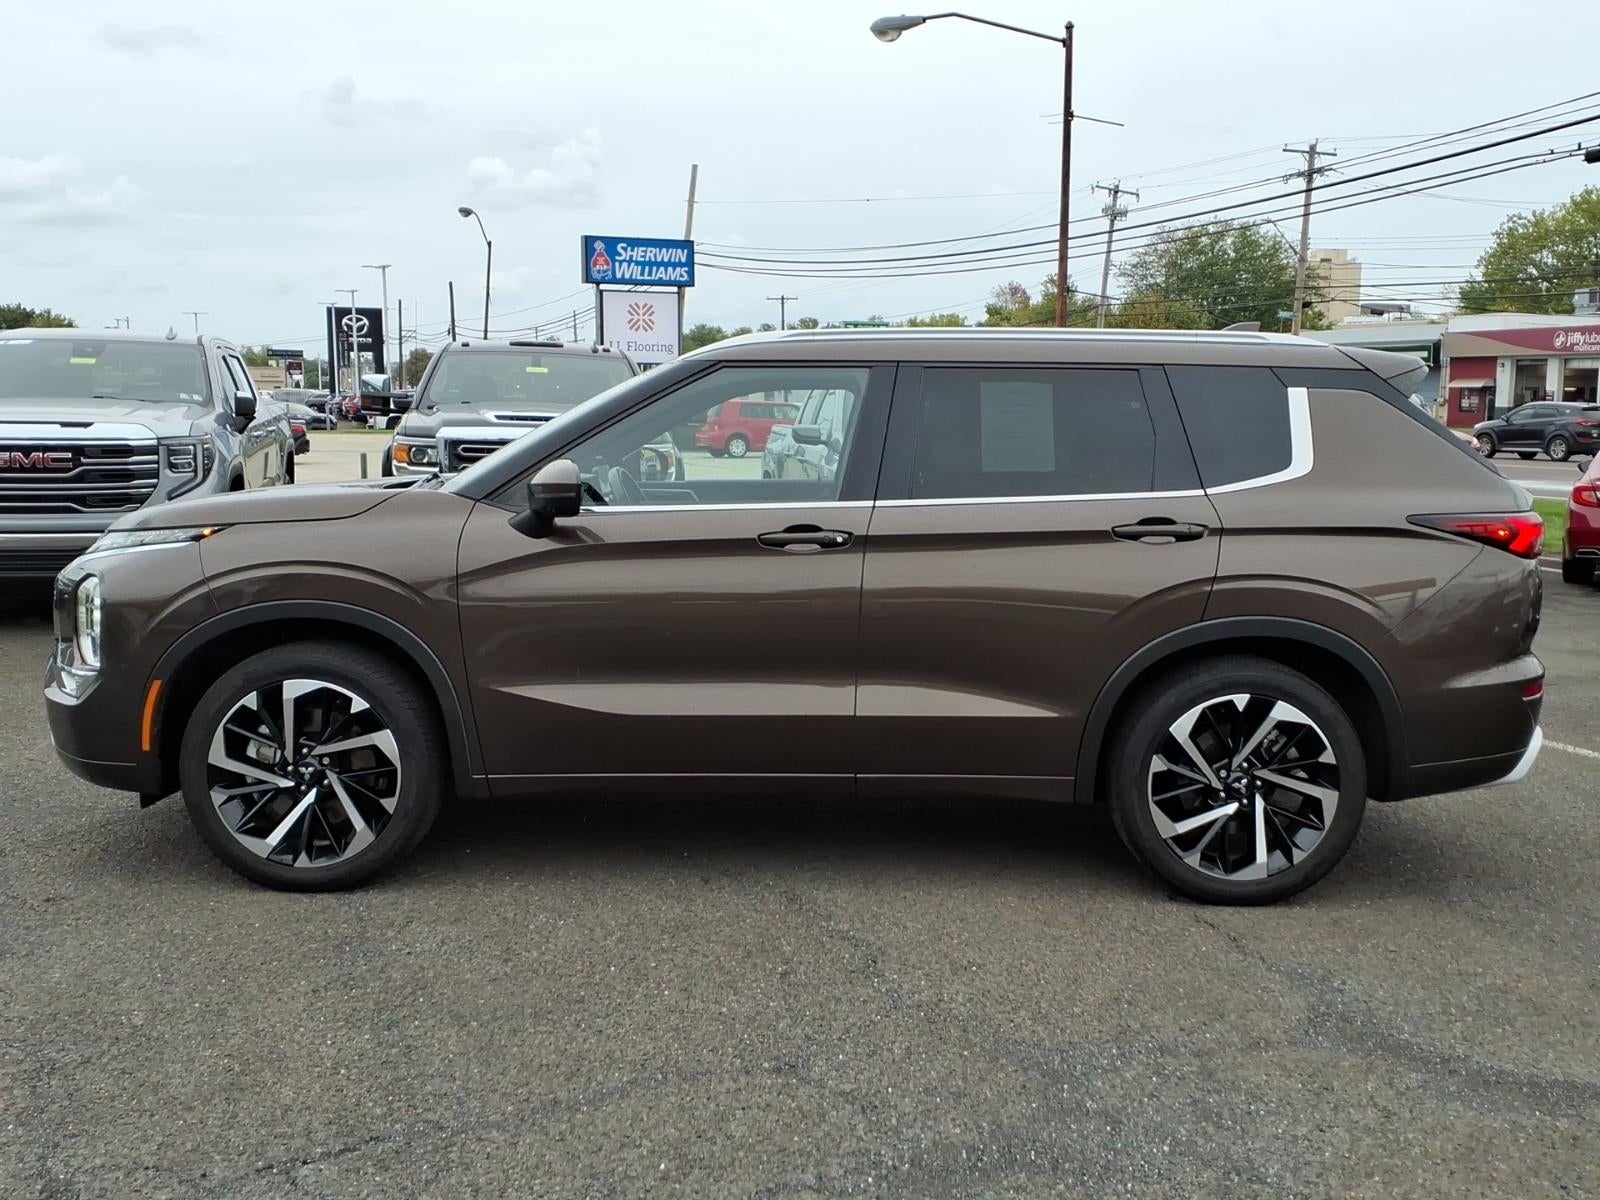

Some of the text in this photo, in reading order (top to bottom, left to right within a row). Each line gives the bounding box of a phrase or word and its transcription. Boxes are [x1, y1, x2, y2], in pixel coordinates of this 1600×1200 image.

[615, 243, 688, 263] SHERWIN
[615, 261, 689, 281] WILLIAMS
[627, 341, 674, 355] Flooring
[1566, 331, 1585, 347] jiffy
